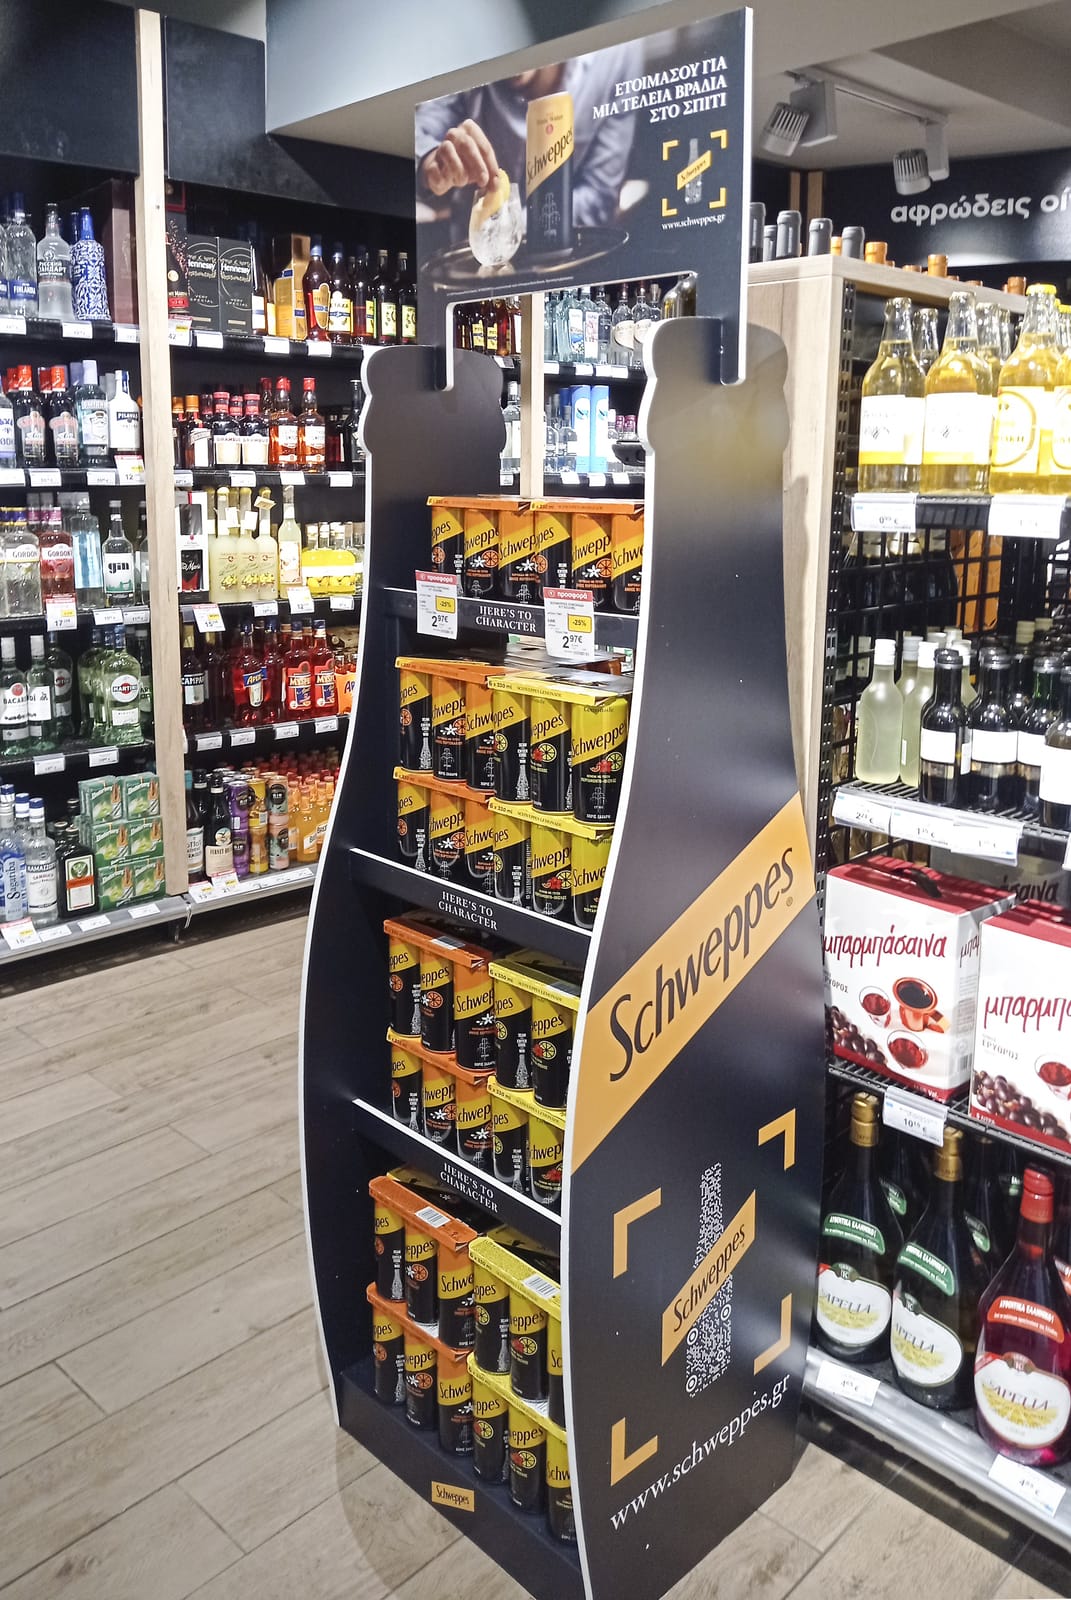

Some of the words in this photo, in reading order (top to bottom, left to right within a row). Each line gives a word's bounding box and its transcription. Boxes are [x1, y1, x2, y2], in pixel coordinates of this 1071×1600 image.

[615, 62, 700, 97] ΕΤΟΙΜΑΣΟΥ
[702, 55, 728, 75] ΓΙΑ
[593, 100, 619, 120] ΜΙΑ
[622, 89, 673, 112] ΤΕΛΕΙΑ
[675, 74, 728, 99] ΒΡΑΔΙΑ
[650, 104, 680, 123] ΣΤΟ
[683, 92, 727, 116] ΣΠΙΤΙ
[891, 193, 1033, 227] αφρώδεις
[1040, 186, 1071, 213] οί
[661, 213, 726, 231] www.schweppes.gr
[108, 562, 129, 574] gin
[427, 575, 454, 584] προσφορά
[557, 591, 588, 601] προσφορά
[475, 615, 537, 633] CHARACTER
[480, 605, 516, 618] HERE'S
[518, 610, 532, 620] TO
[572, 619, 587, 627] -25%
[438, 901, 498, 930] CHARACTER
[442, 891, 478, 911] HERE'S
[479, 906, 493, 917] TO
[823, 924, 947, 968] μπαρμπάσαινα
[610, 847, 793, 1082] Schweppes
[440, 1171, 498, 1213] CHARACTER
[444, 1162, 478, 1189] HERE'S
[480, 1185, 494, 1199] TO
[673, 1223, 745, 1332] Schweppes
[610, 1372, 790, 1531] www.schweppes.gr
[436, 1484, 470, 1505] Schweppes
